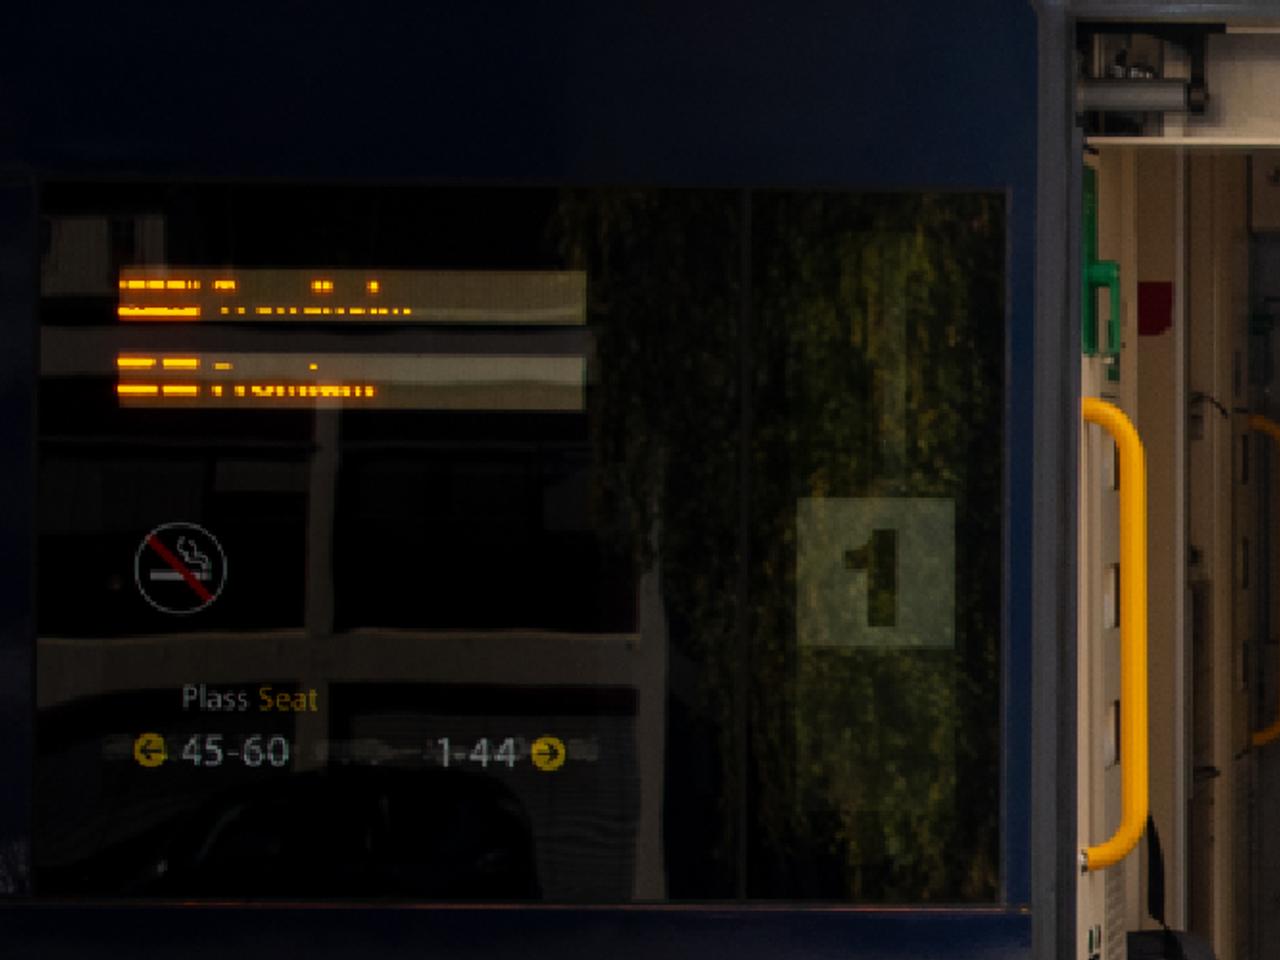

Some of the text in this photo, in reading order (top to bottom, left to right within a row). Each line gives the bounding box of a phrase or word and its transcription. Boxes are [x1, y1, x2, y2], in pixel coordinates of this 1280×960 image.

[845, 529, 896, 627] 1
[182, 685, 318, 711] Plass Seat
[182, 733, 289, 767] 45-60
[437, 736, 518, 767] 1-44
